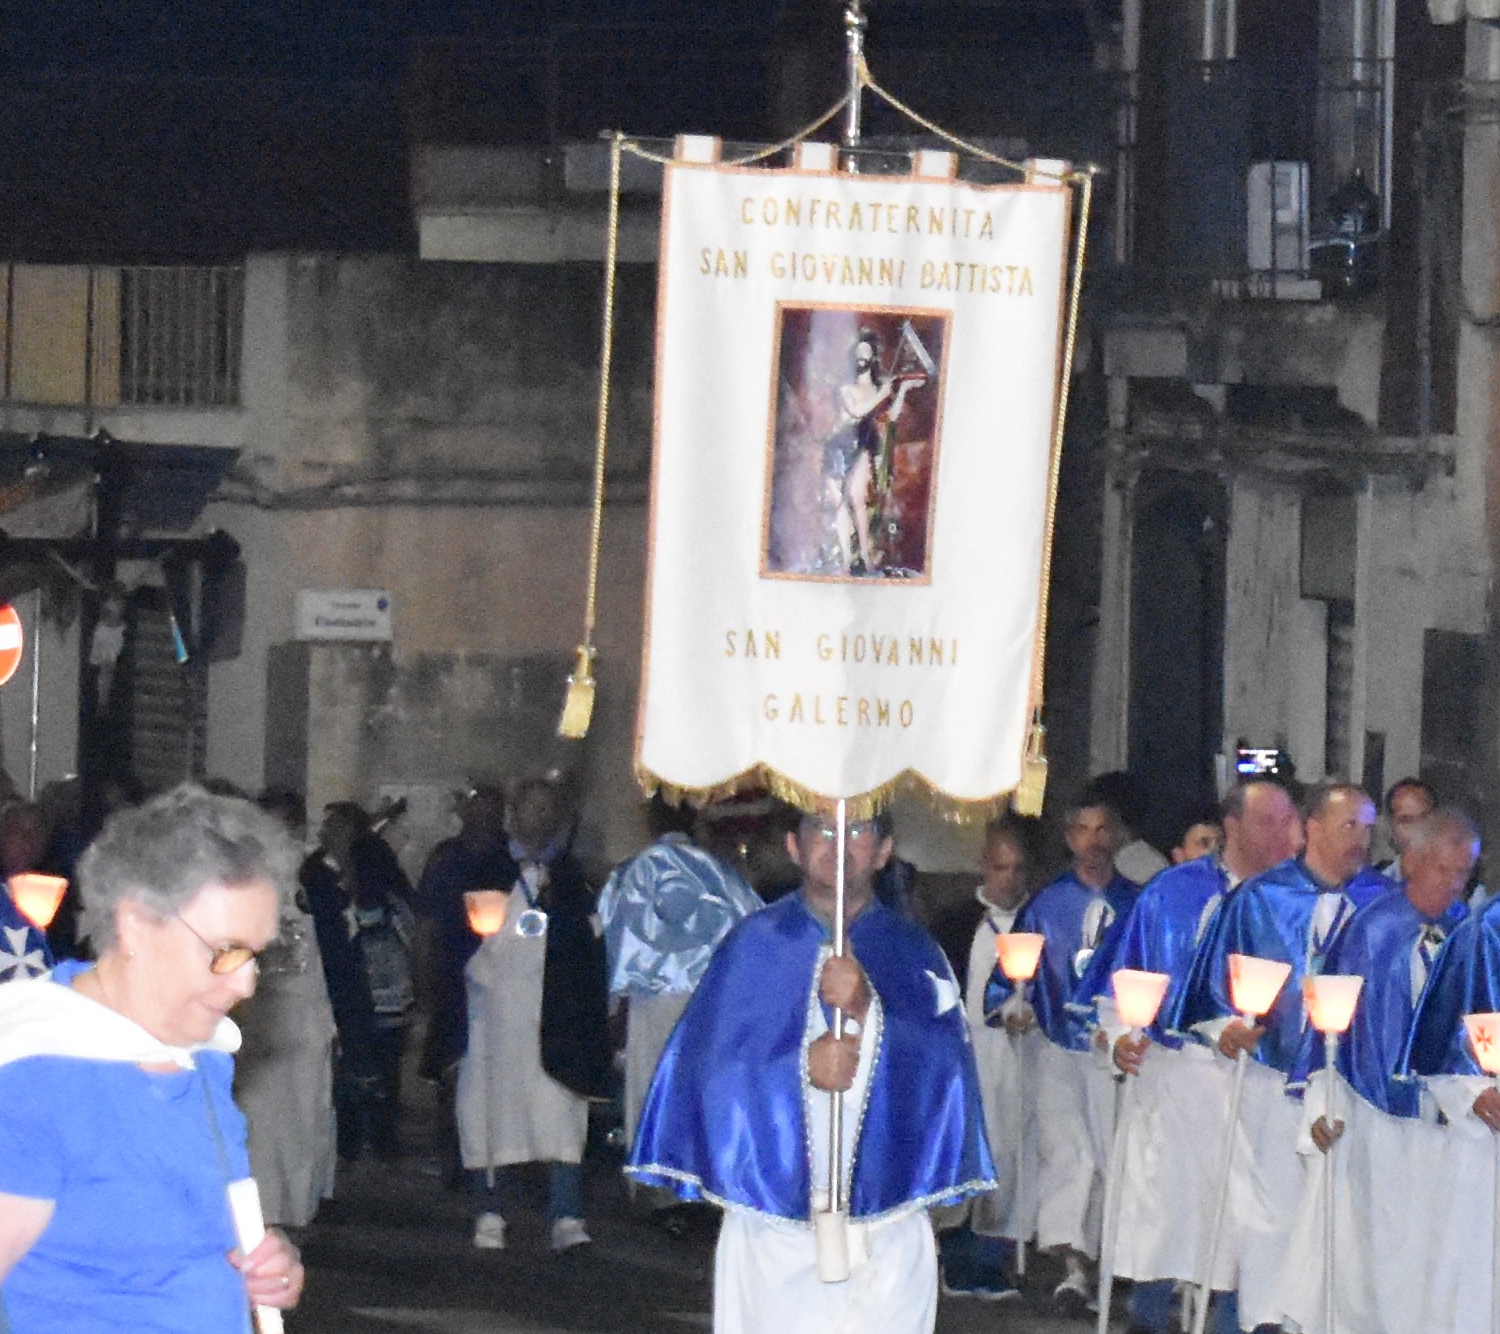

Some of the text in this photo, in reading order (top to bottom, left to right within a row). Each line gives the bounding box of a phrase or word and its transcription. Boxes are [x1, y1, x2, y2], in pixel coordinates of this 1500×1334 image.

[741, 197, 995, 240] CONFRATERNITA
[700, 247, 1034, 297] SAN GIOVANNI BATTISTA
[725, 629, 958, 666] SAN GIOVANNI
[763, 693, 915, 729] GALERMO
